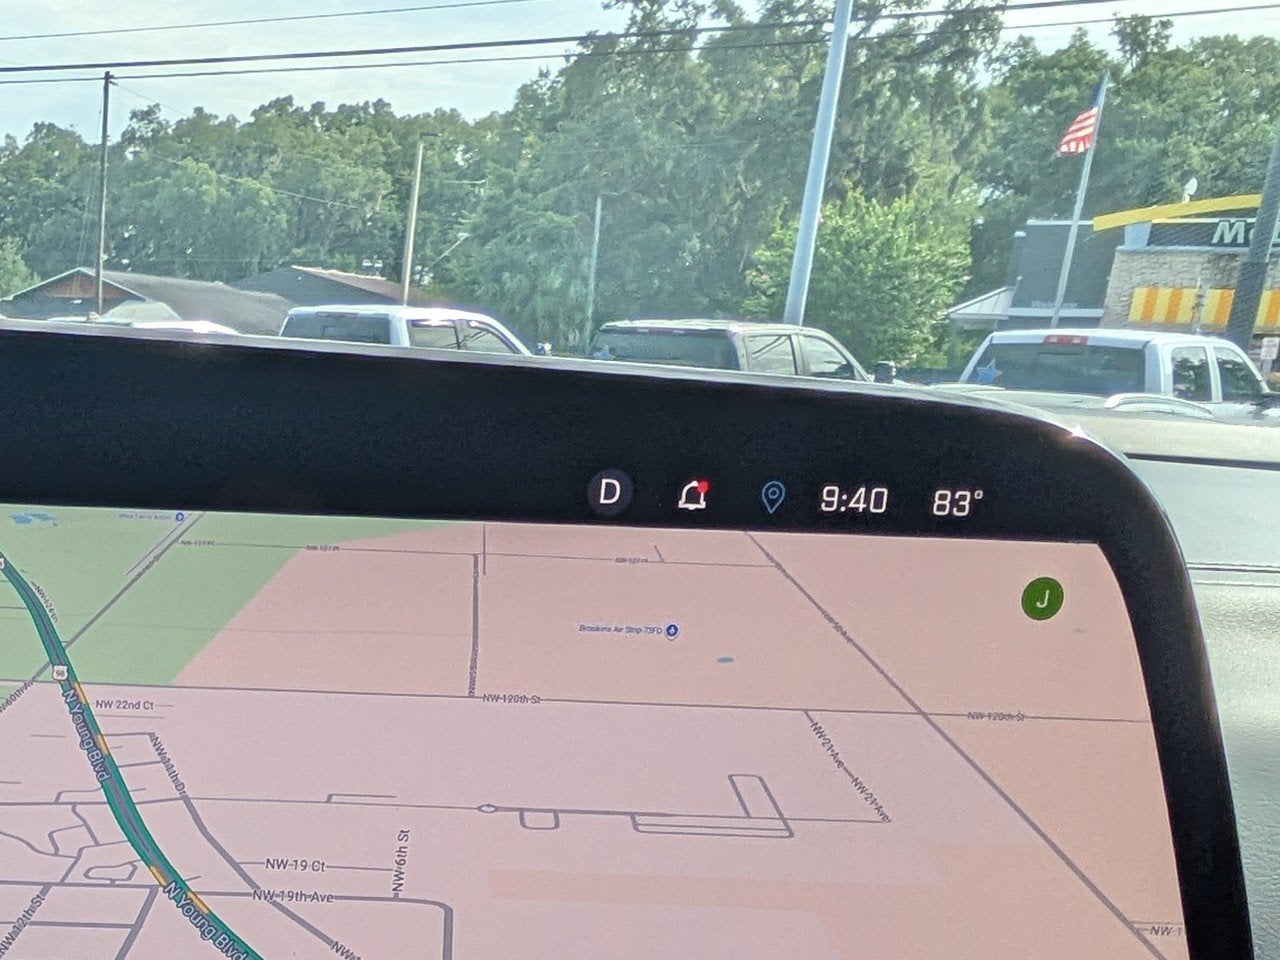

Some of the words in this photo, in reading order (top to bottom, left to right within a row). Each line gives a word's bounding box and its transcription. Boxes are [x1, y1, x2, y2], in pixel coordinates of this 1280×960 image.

[599, 479, 620, 504] D
[821, 485, 889, 514] 9:40
[933, 489, 983, 517] 83°
[1037, 590, 1049, 608] J
[64, 690, 77, 703] N
[95, 700, 113, 709] NW
[116, 700, 141, 710] 22nd
[143, 701, 154, 710] Ct
[483, 694, 500, 703] NW
[502, 694, 529, 703] 120th
[70, 704, 95, 750] Young
[811, 722, 827, 739] NW
[822, 738, 834, 752] 21
[830, 752, 844, 769] Ave
[88, 750, 111, 781] Blvd
[151, 736, 167, 757] NW
[175, 782, 186, 796] Dr
[851, 777, 868, 795] NW
[397, 829, 410, 843] St
[265, 858, 289, 871] NW
[293, 859, 308, 872] 19
[311, 860, 326, 873] Ct
[395, 846, 408, 867] 6th
[392, 870, 405, 892] NW
[252, 890, 275, 902] NW
[279, 890, 307, 902] 19th
[310, 891, 334, 903] Ave
[12, 907, 36, 933] 12th
[30, 893, 46, 908] St
[164, 882, 180, 899] N
[178, 894, 216, 940] Young
[1150, 926, 1173, 936] NW
[331, 941, 354, 960] NW
